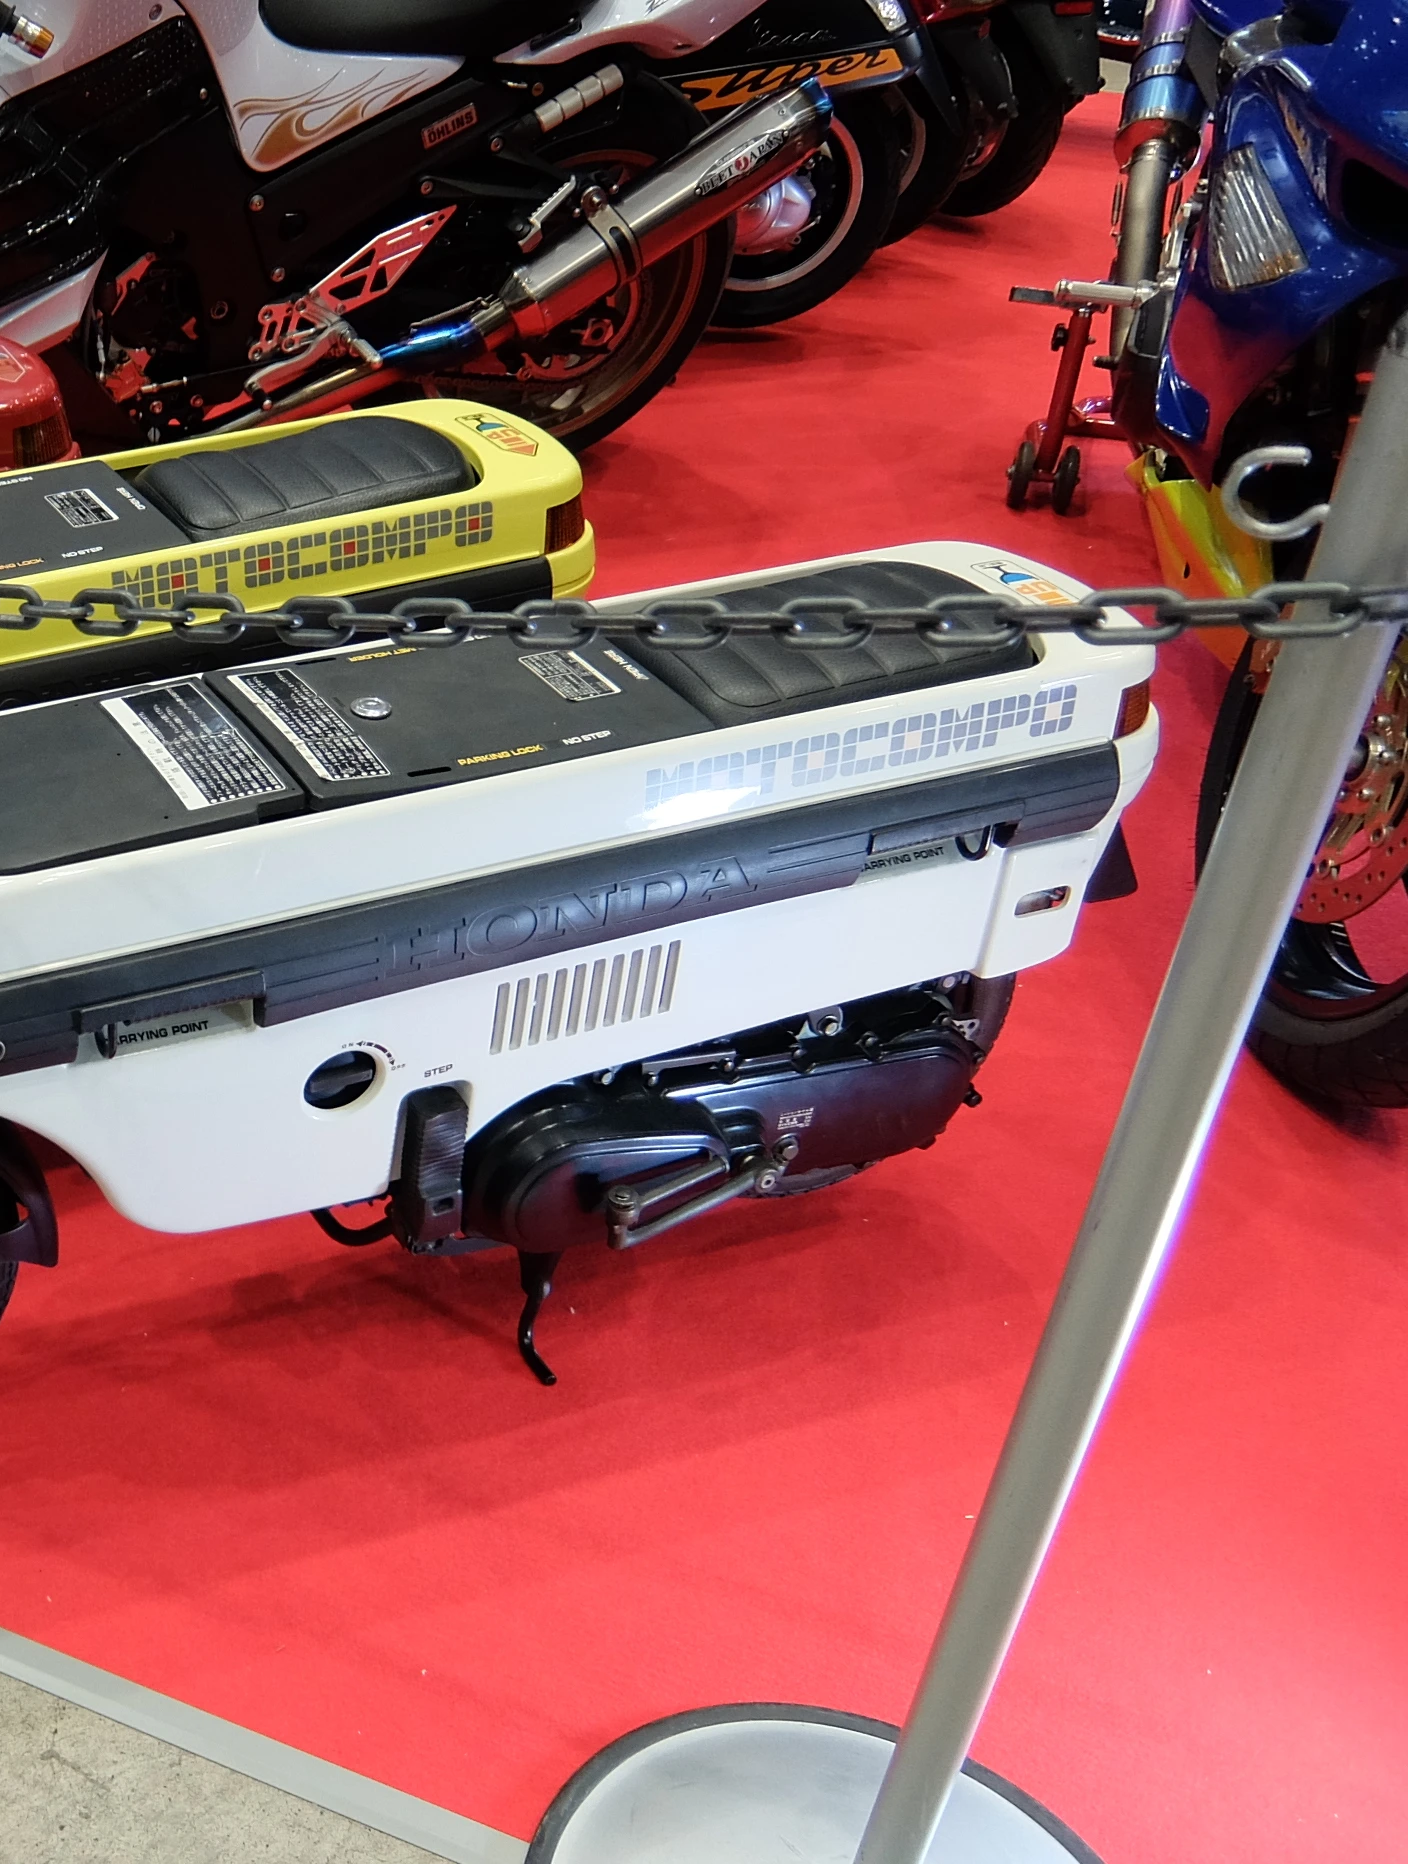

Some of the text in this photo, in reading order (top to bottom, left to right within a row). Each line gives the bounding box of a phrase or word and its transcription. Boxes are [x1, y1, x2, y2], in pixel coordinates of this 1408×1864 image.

[701, 166, 734, 193] BEET
[16, 557, 45, 567] LOCK
[61, 545, 104, 559] NO STEP
[111, 500, 492, 608] MOTOCOMPO
[562, 729, 612, 746] NO STEP
[645, 684, 1078, 815] MOTOCOMPO
[457, 743, 545, 766] PARKING LOCK
[861, 846, 945, 872] ARRYING POINT
[384, 855, 759, 976] HONDA
[116, 1020, 209, 1046] RRYING POINT
[424, 1063, 454, 1078] STEP
